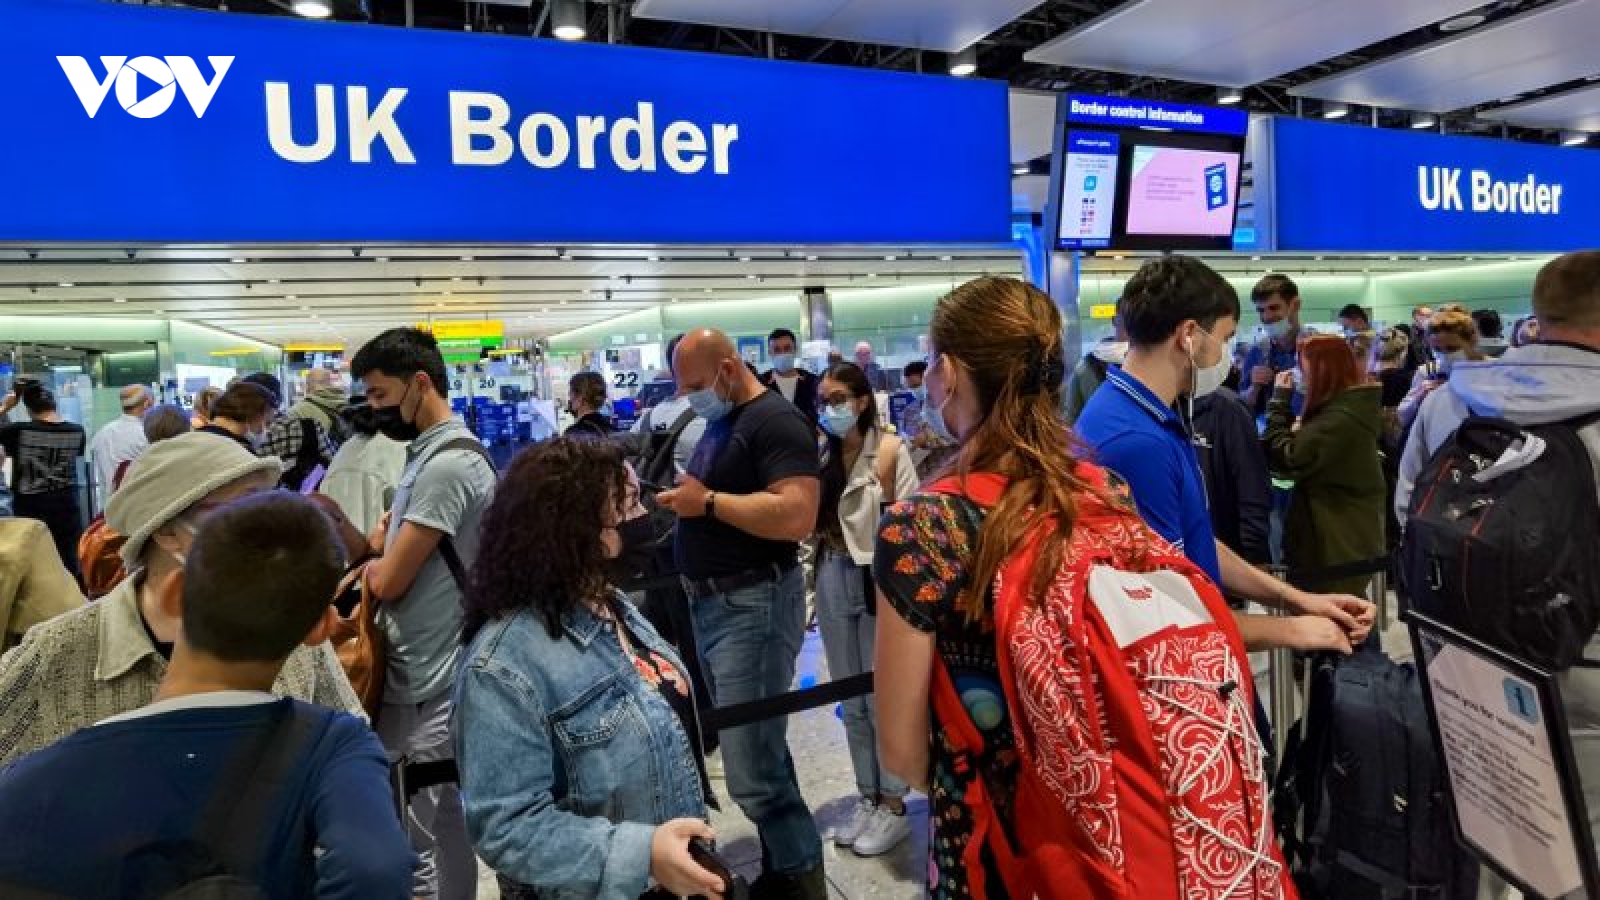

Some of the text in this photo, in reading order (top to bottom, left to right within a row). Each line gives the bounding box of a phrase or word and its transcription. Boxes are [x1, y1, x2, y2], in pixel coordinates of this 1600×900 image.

[1071, 99, 1205, 124] Border control information
[265, 81, 739, 174] UK Border
[1418, 165, 1563, 215] UK Border
[479, 377, 496, 389] 20
[614, 372, 639, 388] 22
